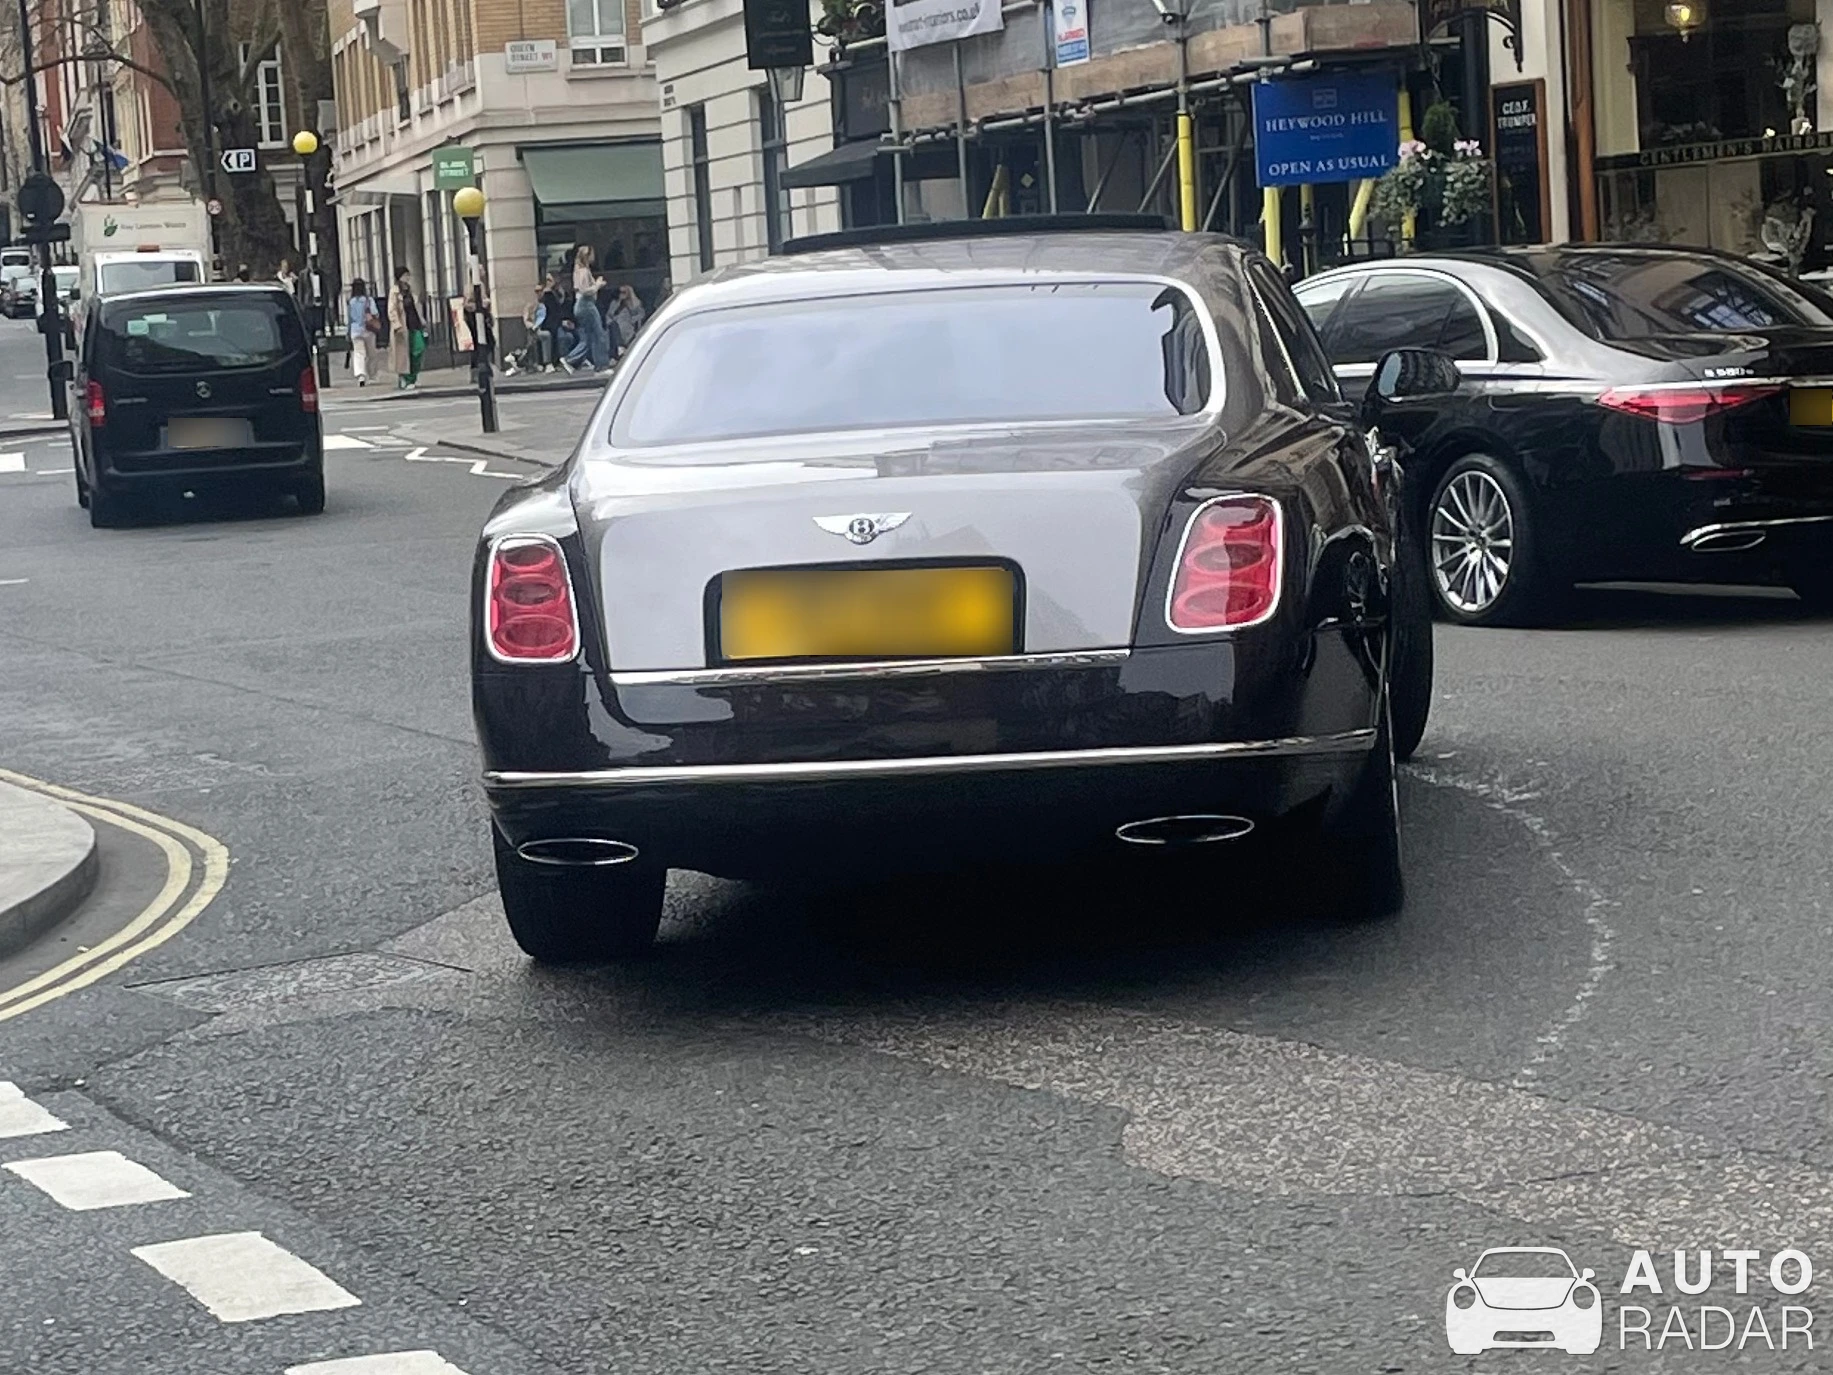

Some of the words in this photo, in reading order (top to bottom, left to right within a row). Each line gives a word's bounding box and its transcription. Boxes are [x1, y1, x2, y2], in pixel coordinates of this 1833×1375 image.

[510, 43, 535, 53] QUEEN
[511, 53, 538, 63] STREET
[1265, 114, 1346, 132] HEYWOOD
[1349, 109, 1389, 124] HILL
[239, 153, 250, 168] P
[1639, 143, 1752, 166] GENTLEMEN'S
[1268, 161, 1312, 176] OPEN
[1315, 160, 1335, 173] AS
[1338, 154, 1390, 170] USUAL
